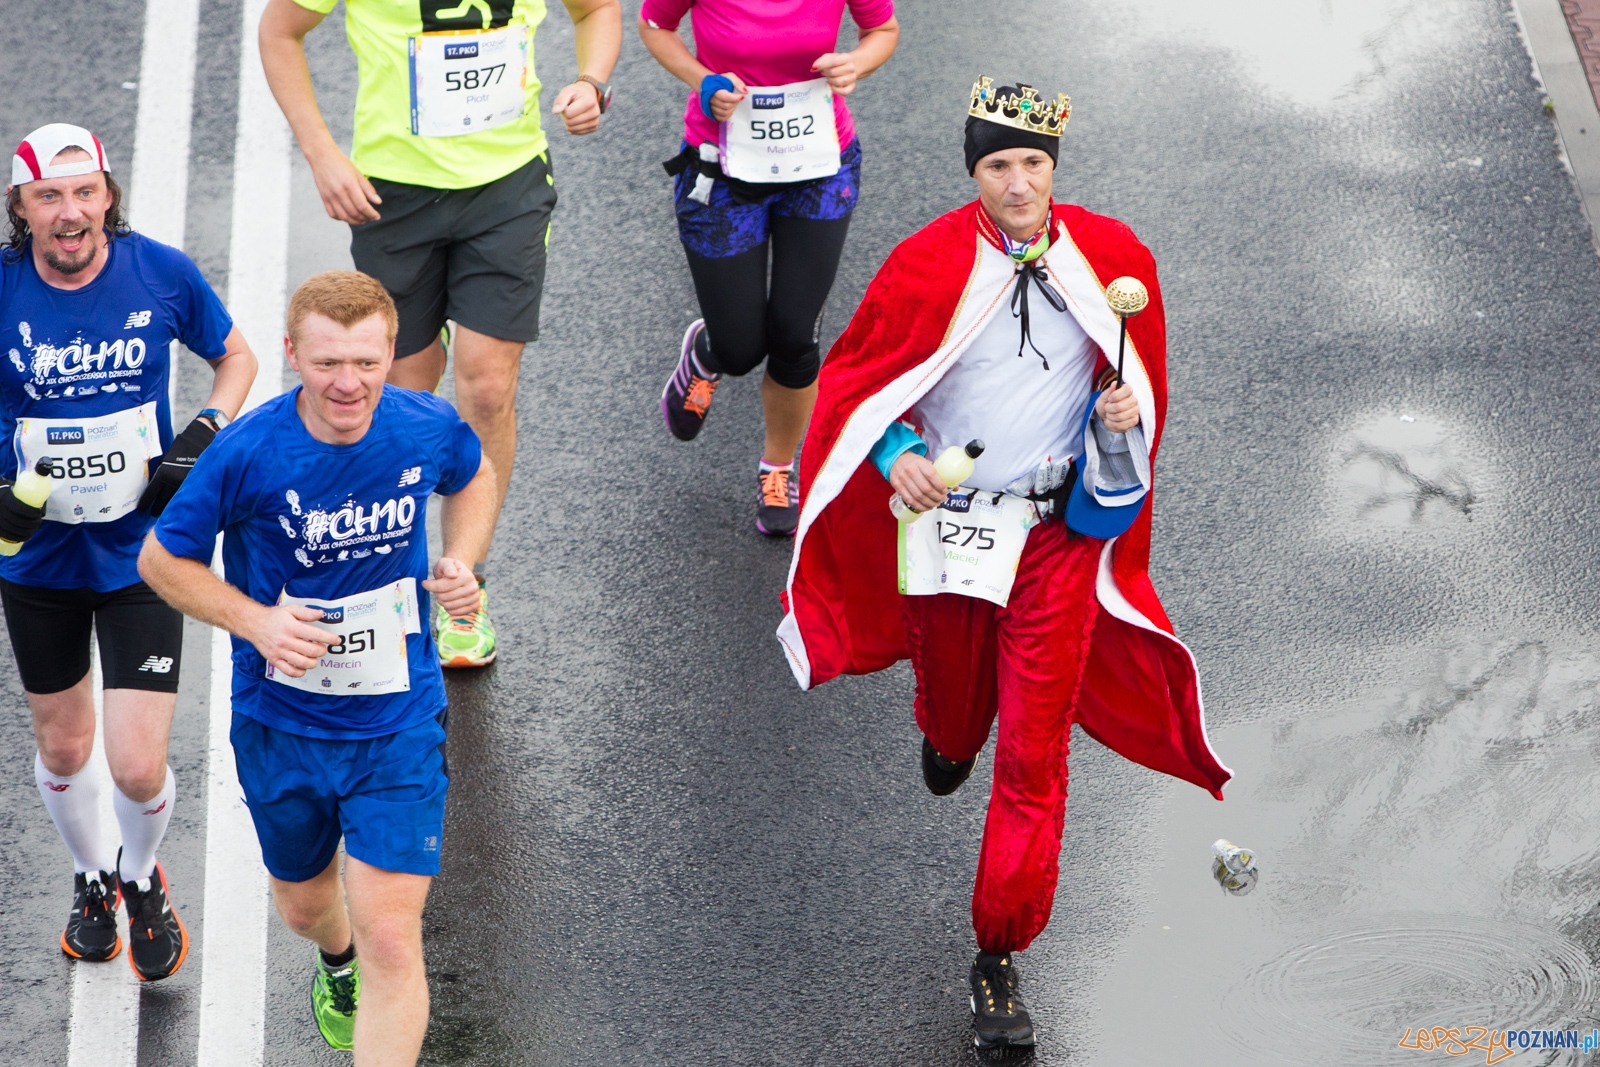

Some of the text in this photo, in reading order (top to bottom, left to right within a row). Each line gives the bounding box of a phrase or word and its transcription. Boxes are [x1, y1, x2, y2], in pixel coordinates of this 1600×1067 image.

[446, 63, 506, 92] 5877
[466, 94, 490, 104] Piotr
[751, 114, 814, 140] 5862
[767, 144, 804, 154] Mariola
[33, 337, 146, 378] #CH10
[70, 482, 108, 495] Paweł
[305, 495, 416, 543] #CH10
[936, 521, 996, 550] 1275
[943, 550, 979, 566] Maciej
[326, 628, 375, 655] 851
[320, 659, 362, 669] Marcin
